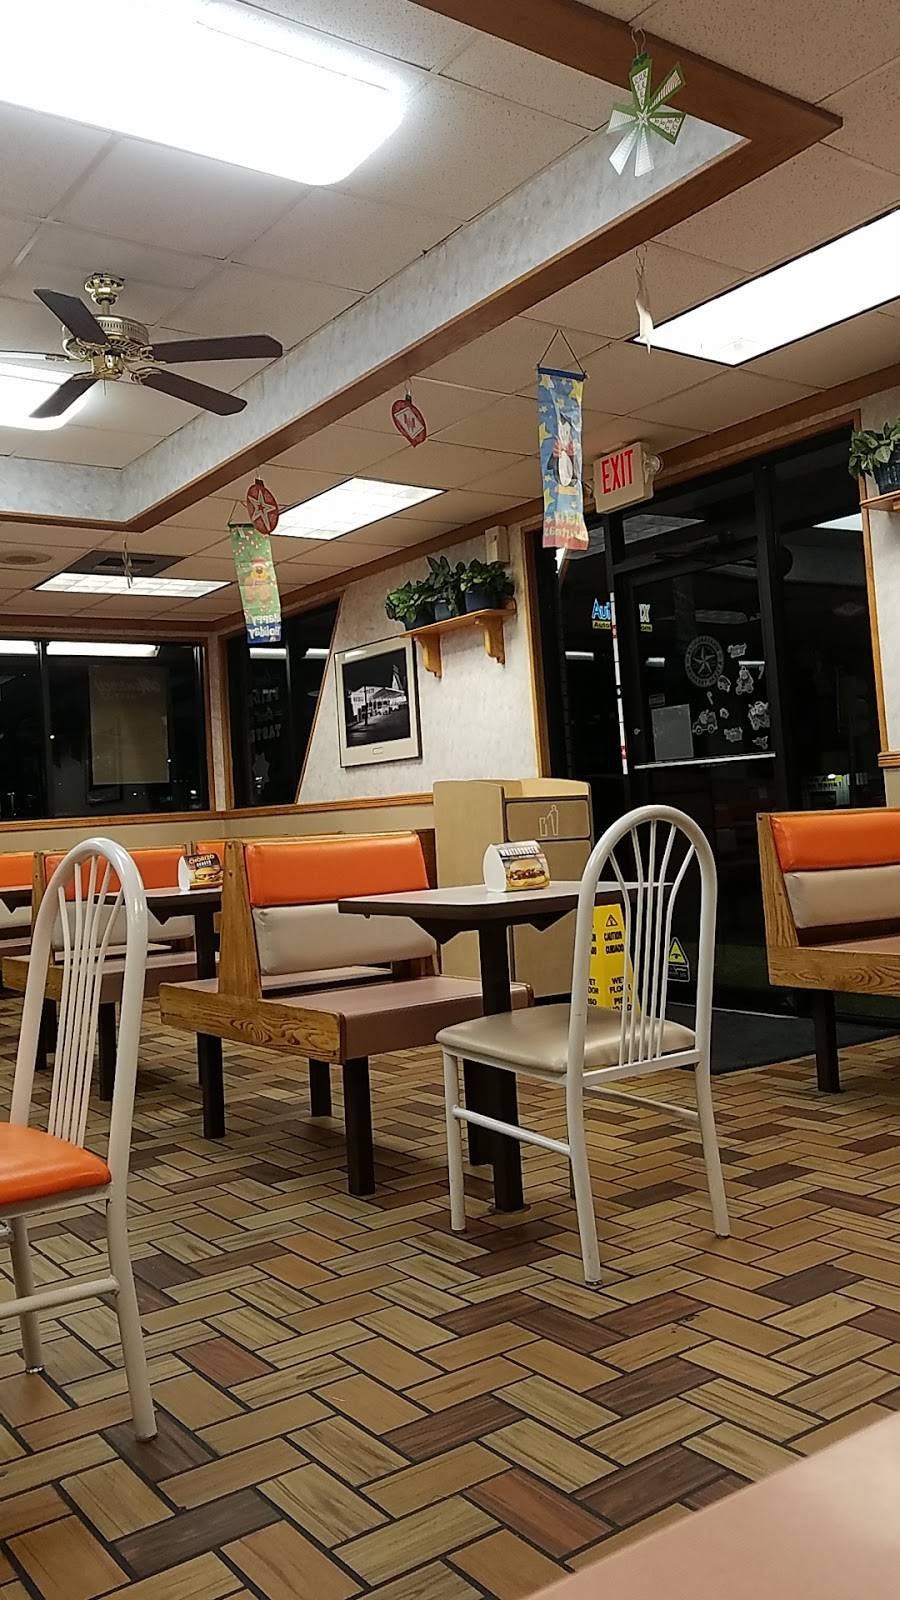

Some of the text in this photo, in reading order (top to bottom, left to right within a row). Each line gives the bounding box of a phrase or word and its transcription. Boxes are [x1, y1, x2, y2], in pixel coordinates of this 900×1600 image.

[601, 449, 634, 494] EXIT
[603, 931, 623, 942] CAUTION
[605, 943, 625, 954] CUIDADO
[588, 978, 596, 986] ET
[587, 986, 599, 995] OOR
[587, 997, 598, 1006] ISO
